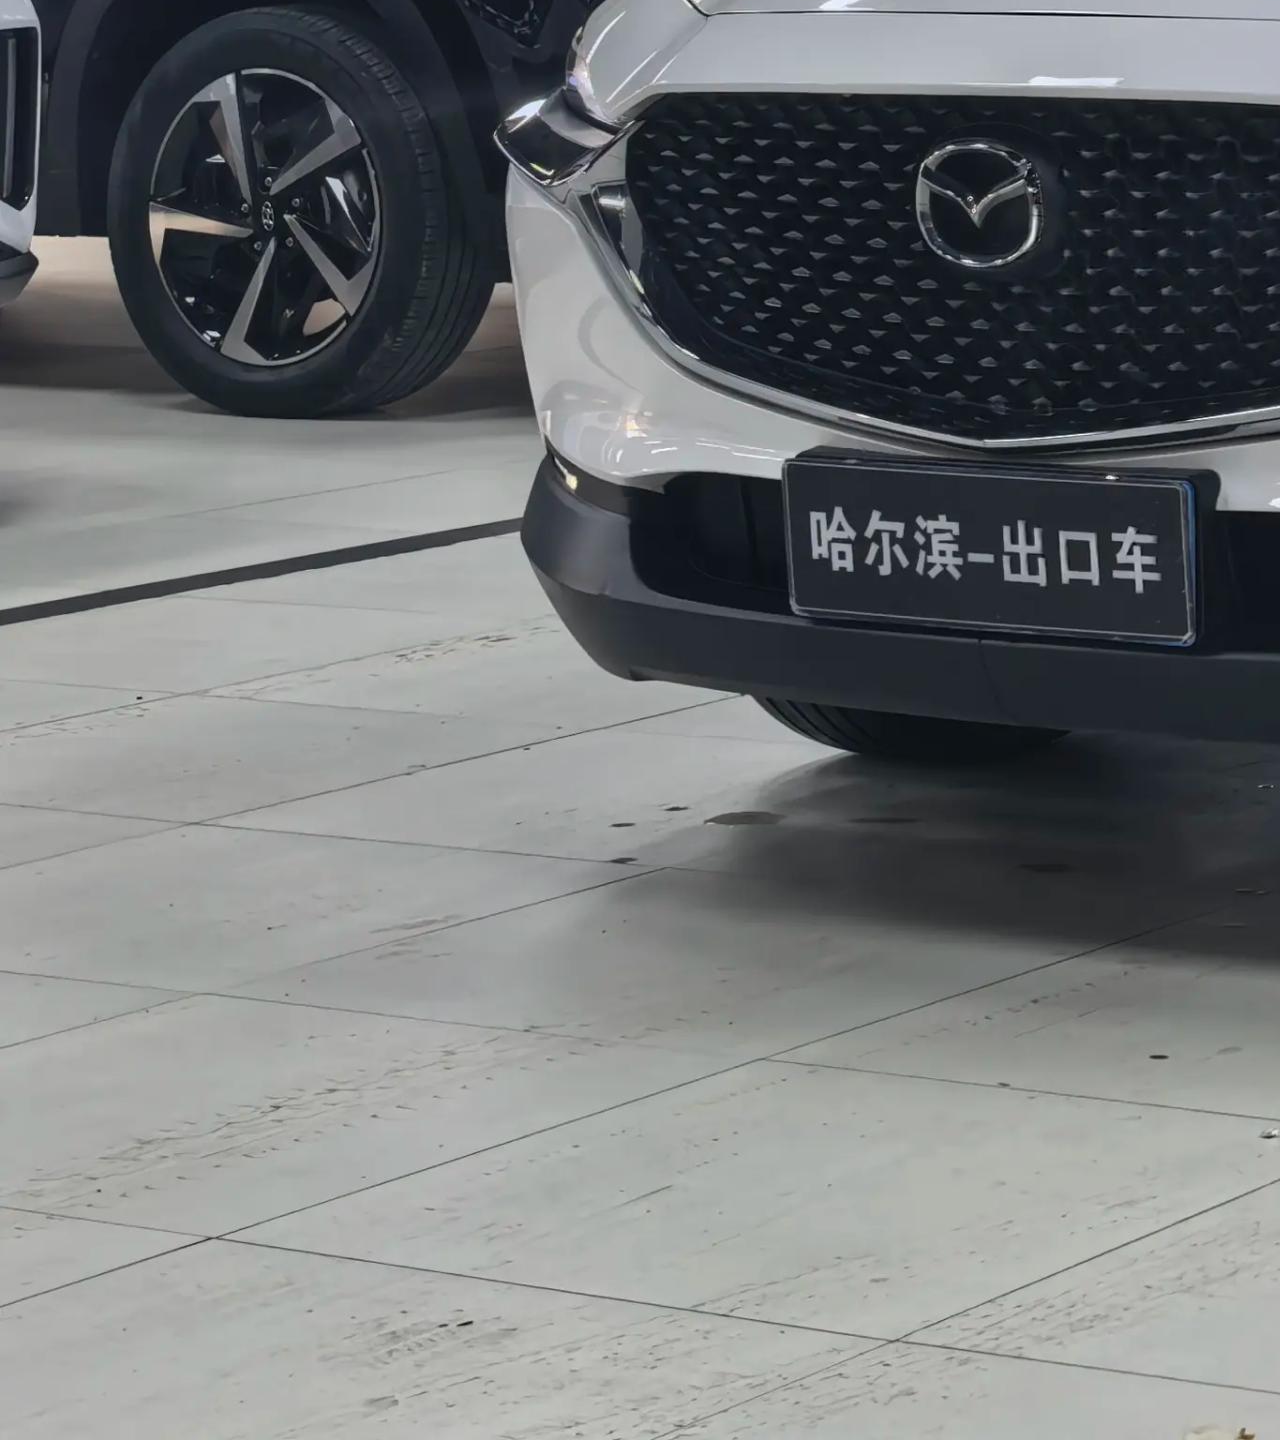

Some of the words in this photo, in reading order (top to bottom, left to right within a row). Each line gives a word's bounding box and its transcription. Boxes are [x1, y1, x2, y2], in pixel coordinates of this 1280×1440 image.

[808, 505, 1163, 595] 哈尔滨-出口车
